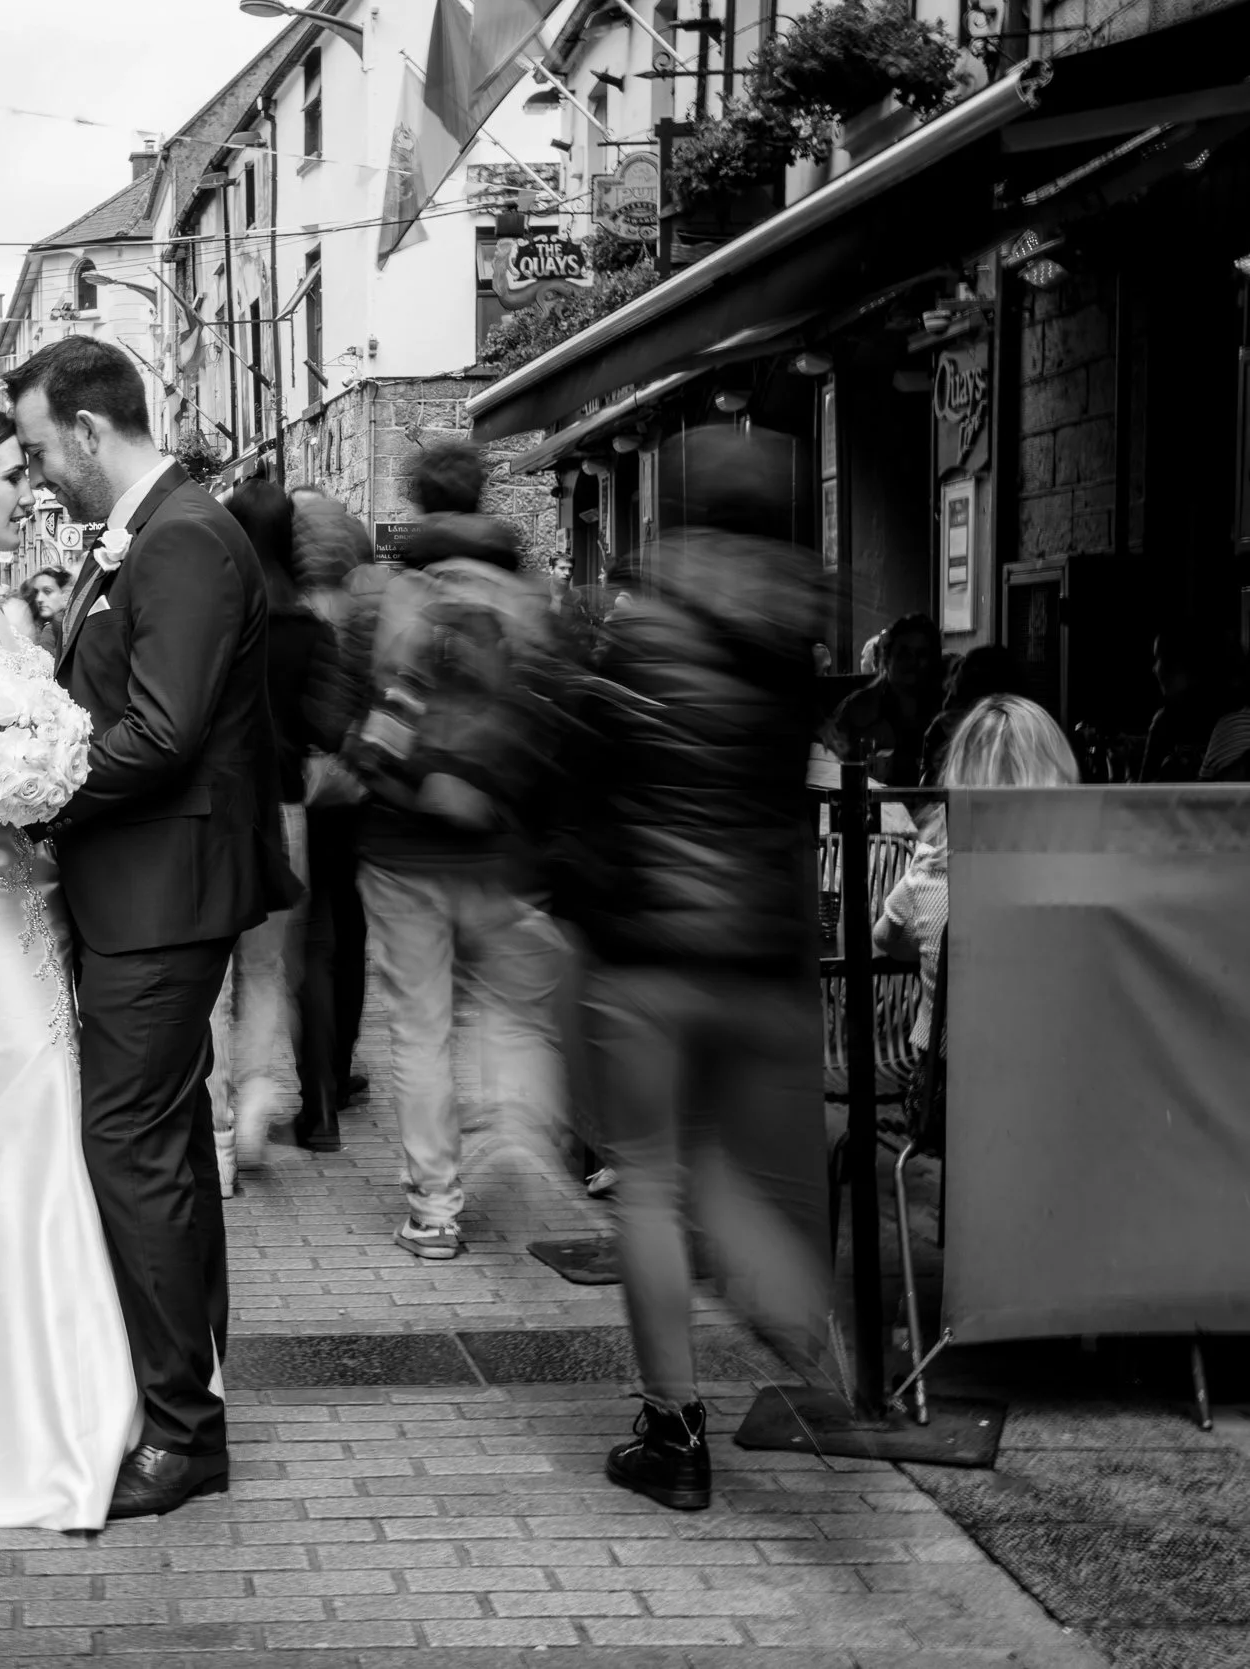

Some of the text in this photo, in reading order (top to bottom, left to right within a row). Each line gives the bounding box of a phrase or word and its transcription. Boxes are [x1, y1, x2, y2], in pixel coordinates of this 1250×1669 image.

[535, 243, 563, 257] THE
[519, 254, 580, 279] QUAYS
[934, 350, 986, 424] Quays
